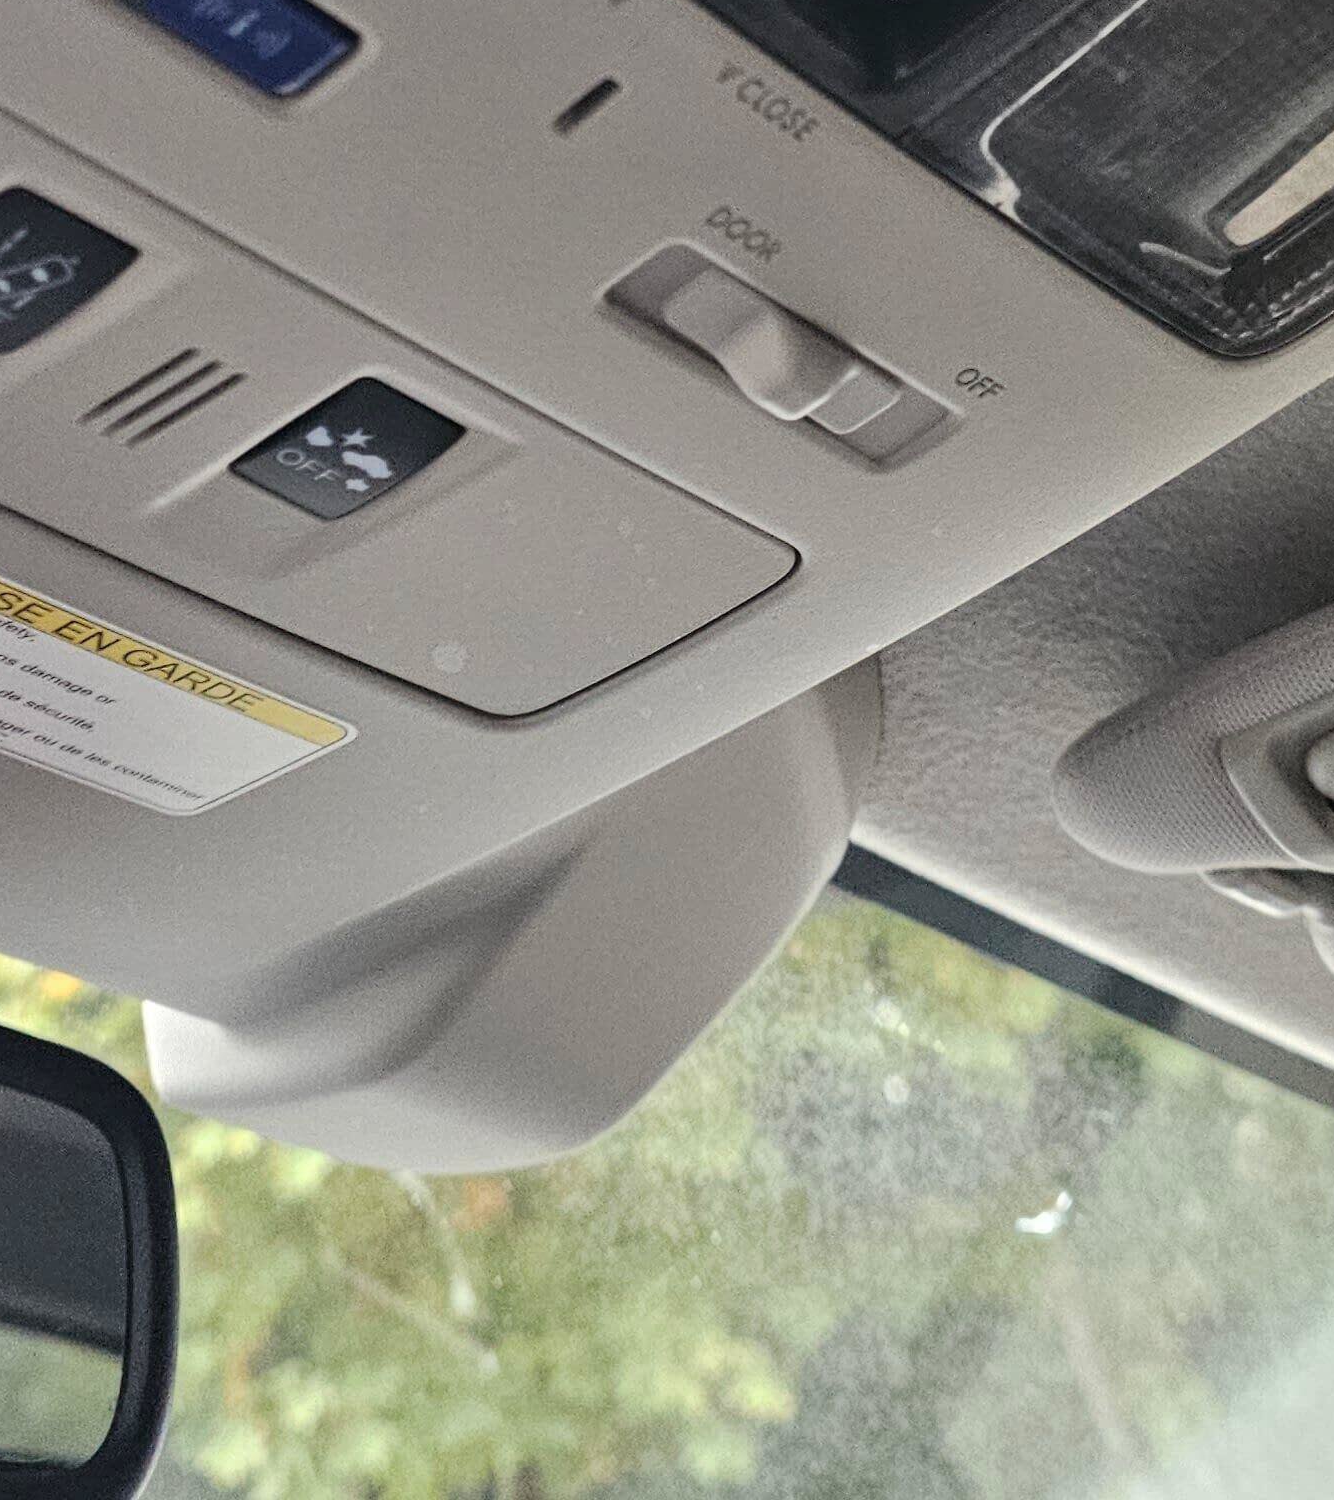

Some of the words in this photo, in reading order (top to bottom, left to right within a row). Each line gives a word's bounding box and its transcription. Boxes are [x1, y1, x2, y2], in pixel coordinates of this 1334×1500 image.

[735, 74, 820, 143] CLOSE
[705, 205, 780, 263] DOOR
[954, 366, 1010, 400] OFF
[277, 449, 342, 484] OFF
[16, 662, 97, 697] damage
[50, 618, 122, 652] EN
[115, 646, 266, 712] GARDE
[21, 697, 103, 733] sécurité,
[110, 762, 206, 802] contaminer
